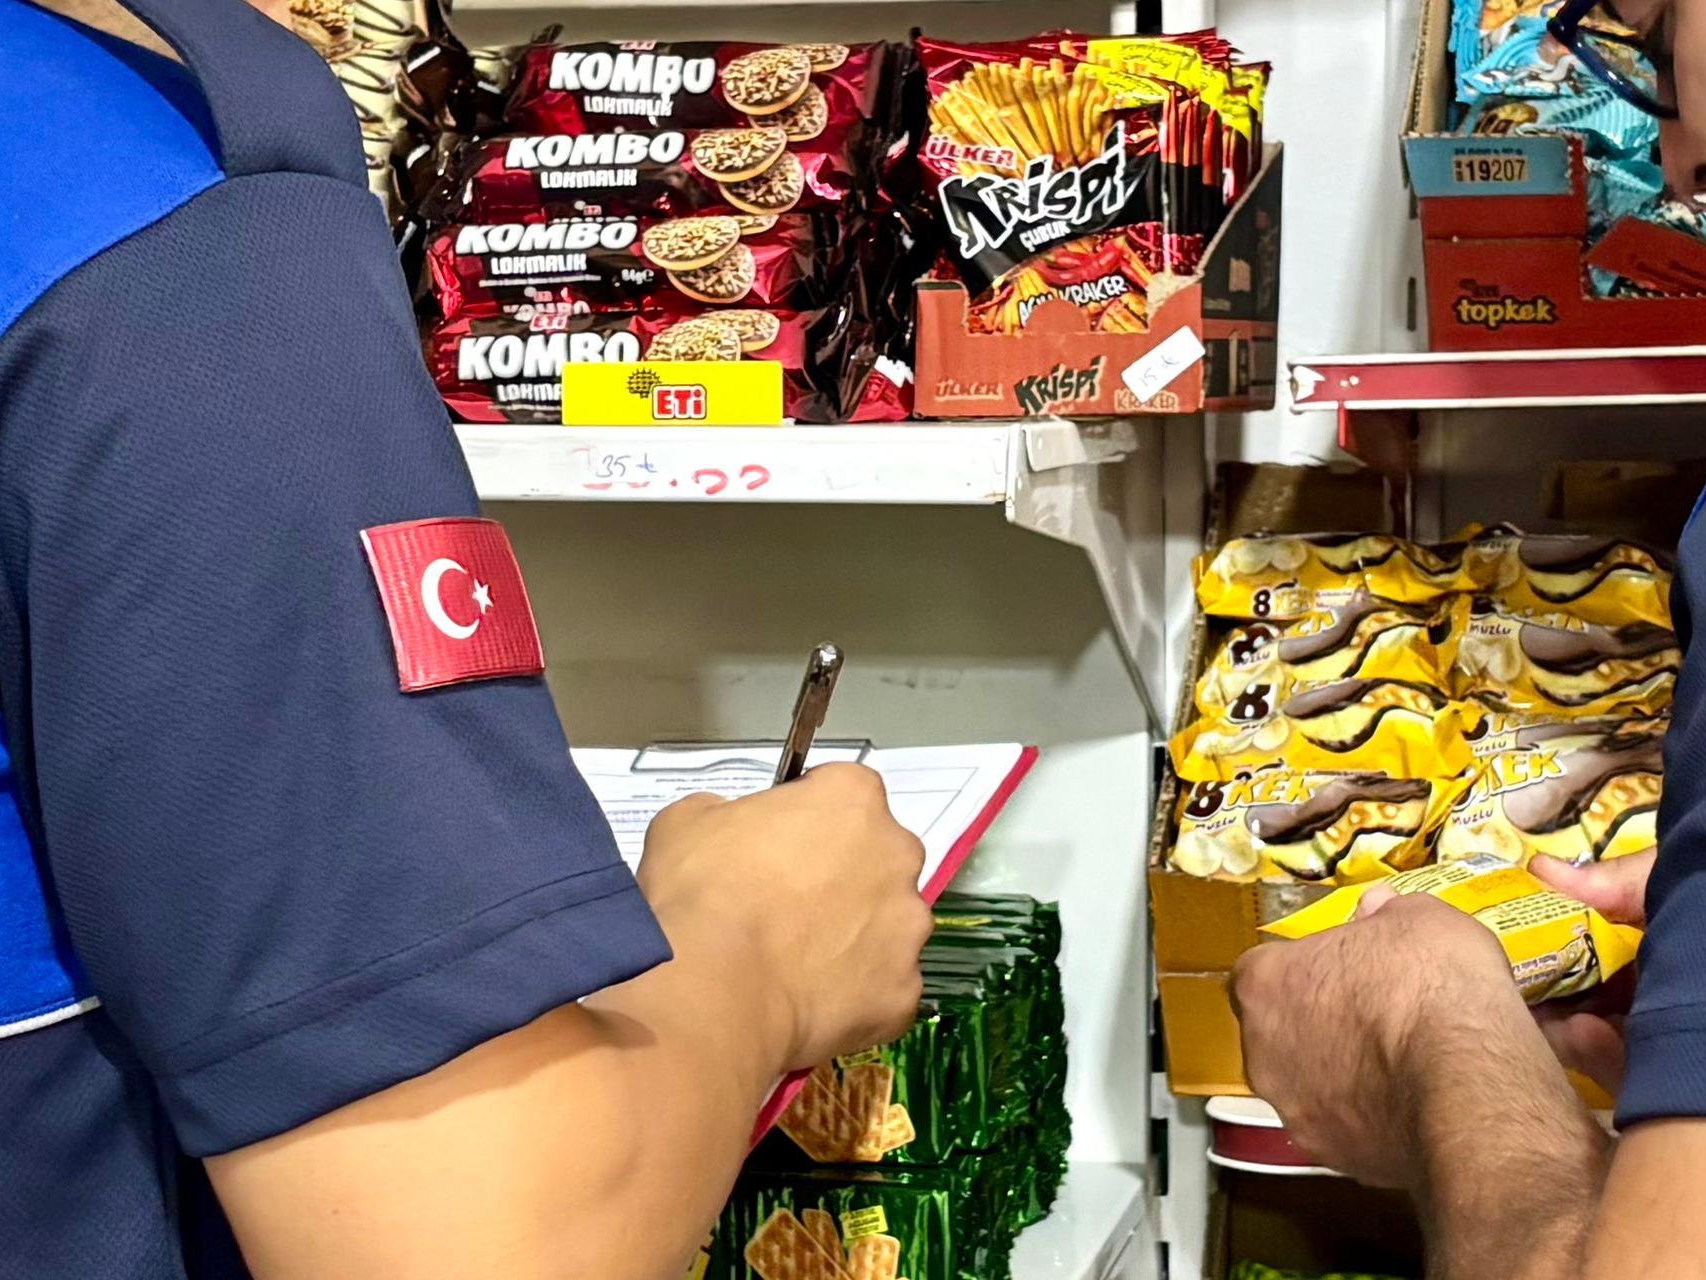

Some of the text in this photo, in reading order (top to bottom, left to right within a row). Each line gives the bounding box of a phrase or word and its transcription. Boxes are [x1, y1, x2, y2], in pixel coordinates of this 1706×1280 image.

[549, 51, 715, 95] KOMBO
[505, 131, 685, 170] KOMBO
[926, 135, 1016, 170] ÜLKER
[539, 169, 638, 191] LOKMALIK
[455, 219, 640, 256] KOMBO
[491, 253, 587, 276] LOKMALIK
[1456, 298, 1555, 326] topkek
[457, 330, 641, 381] KOMBO
[497, 382, 563, 405] LOKMA
[652, 384, 708, 420] ETi
